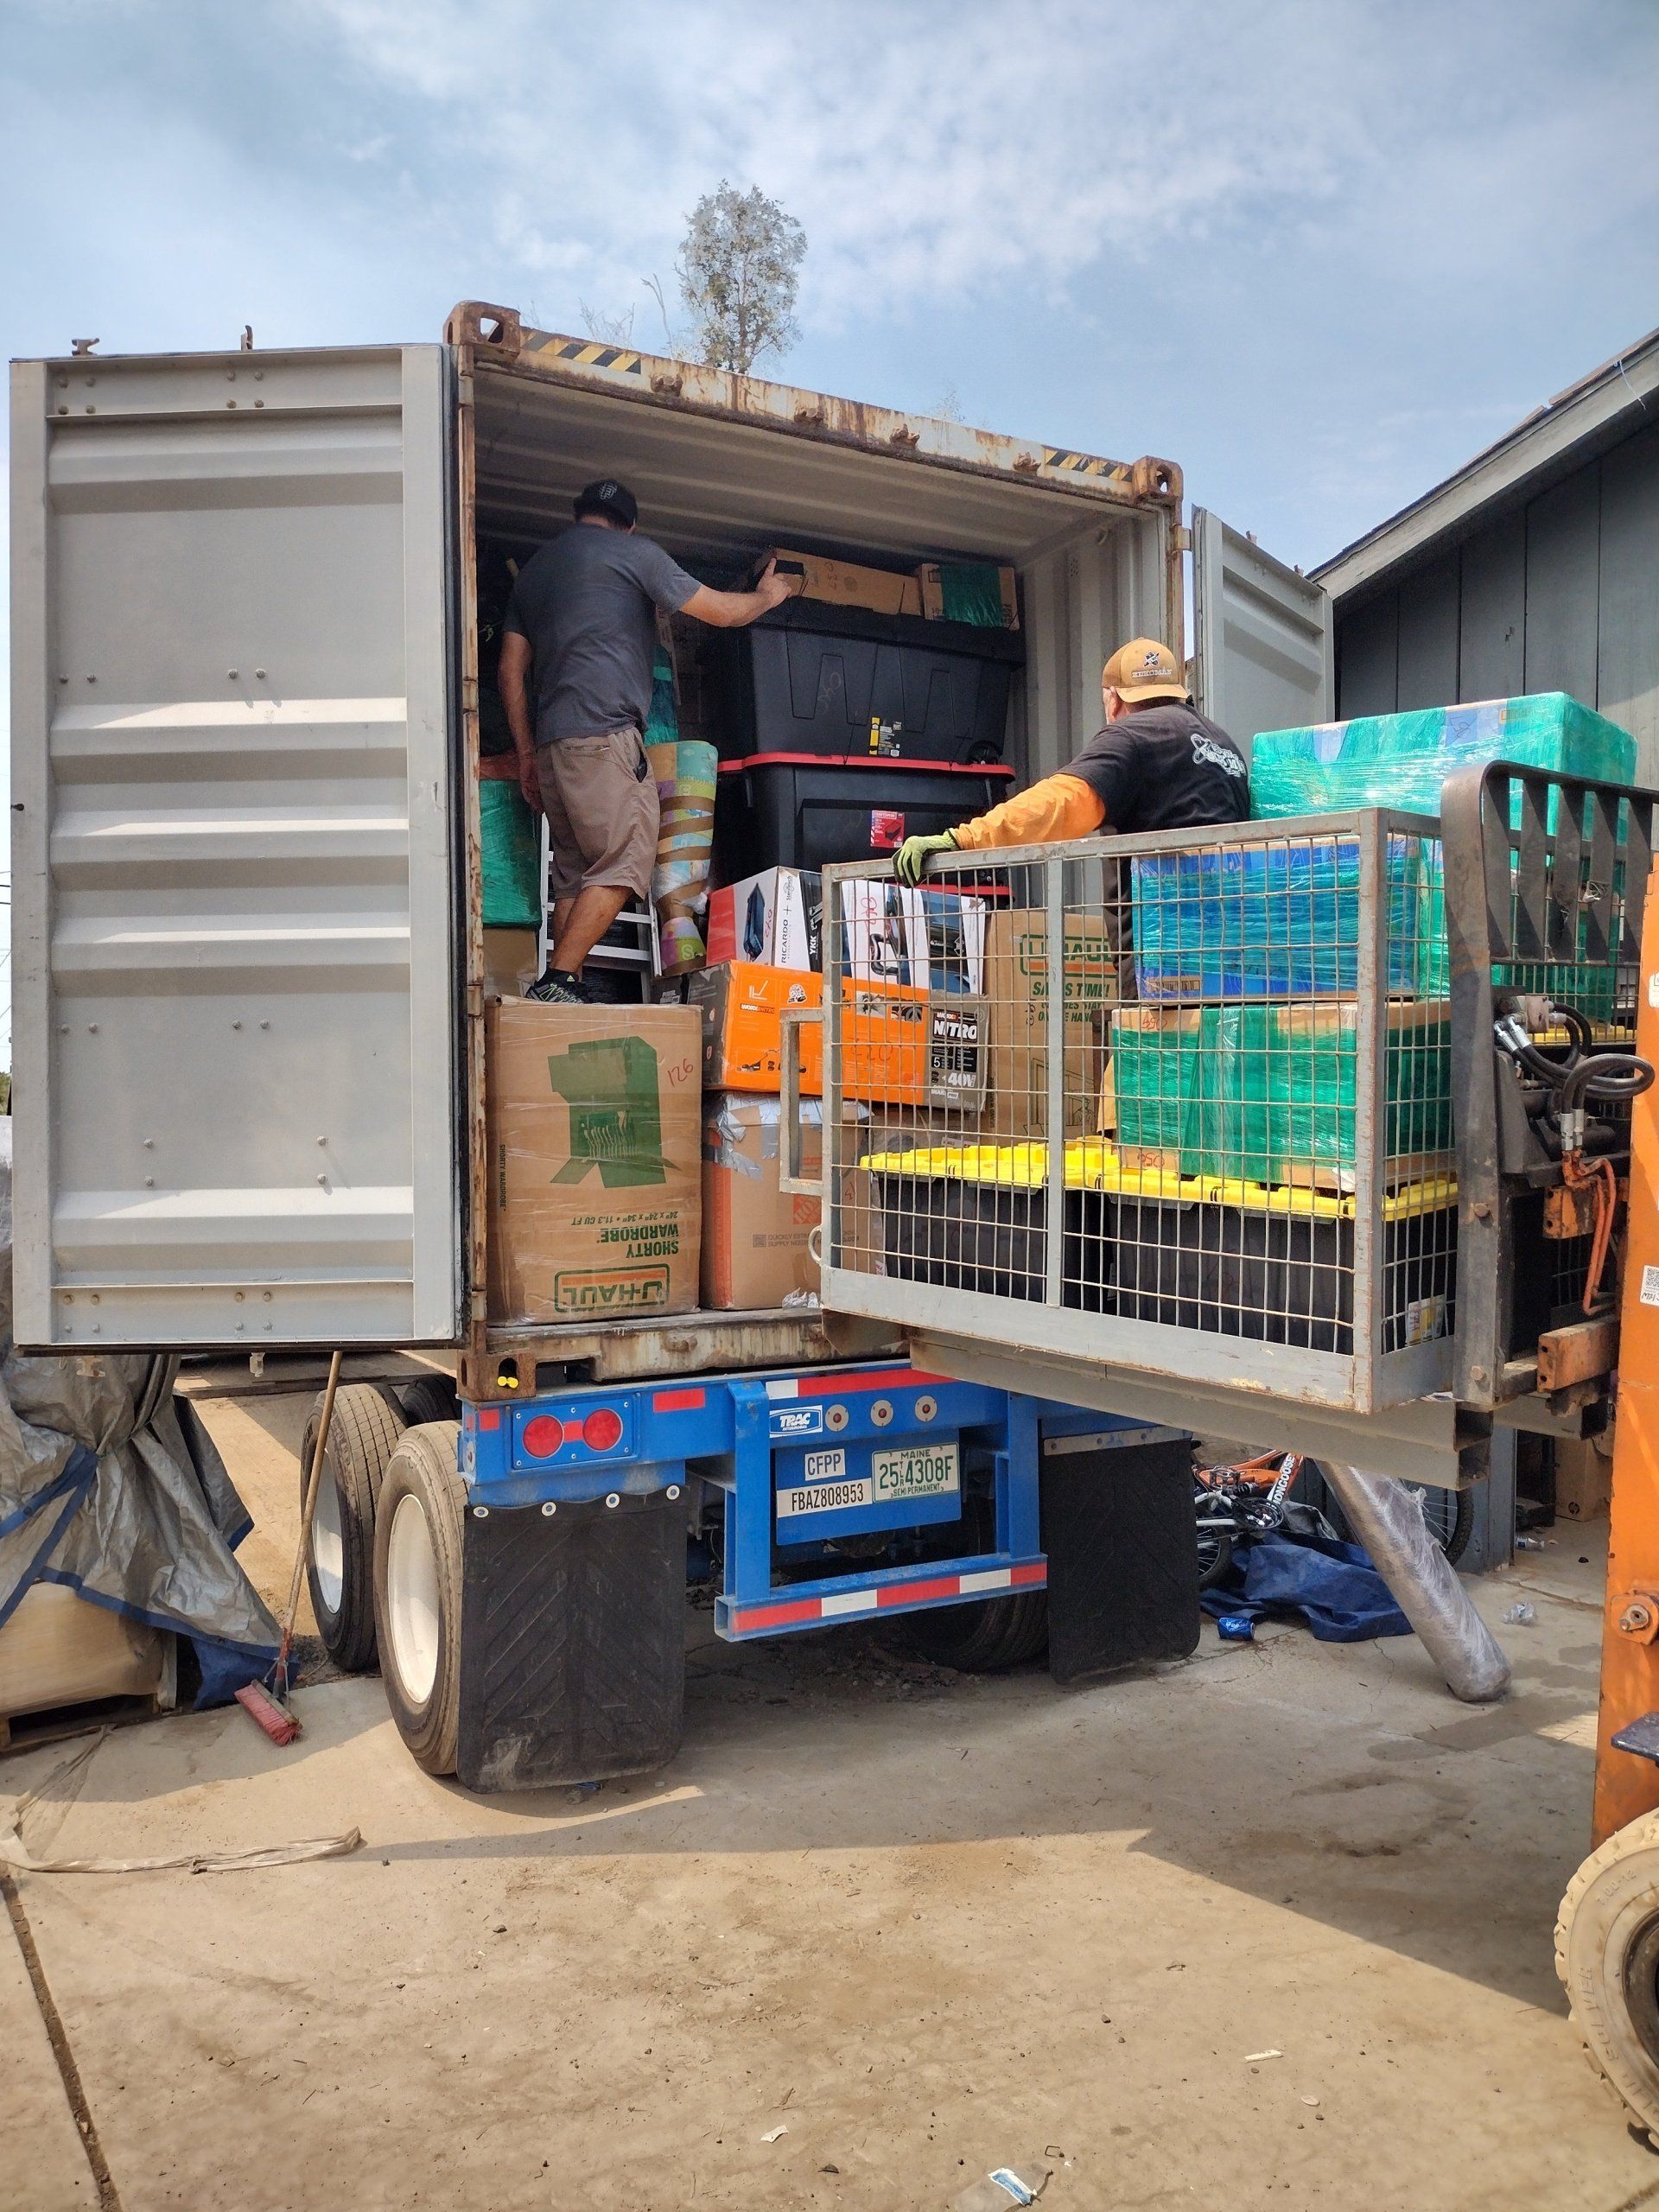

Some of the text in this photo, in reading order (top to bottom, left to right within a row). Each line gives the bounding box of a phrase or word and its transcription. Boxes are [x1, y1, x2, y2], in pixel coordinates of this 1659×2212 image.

[934, 1020, 977, 1040] NITRO
[933, 1057, 941, 1068] 5
[667, 1058, 694, 1088] 126
[584, 1217, 595, 1225] CU
[598, 1216, 613, 1224] 11.3
[626, 1240, 679, 1258] SHORTY
[563, 1280, 663, 1306] U-HAUL
[779, 1412, 810, 1428] TRAC
[900, 1449, 931, 1460] MAINE
[807, 1454, 842, 1476] CFPP
[880, 1462, 899, 1490] 25
[905, 1455, 954, 1486] 4308F
[907, 1483, 940, 1494] PERMANENT
[791, 1484, 864, 1512] FBAZ808953
